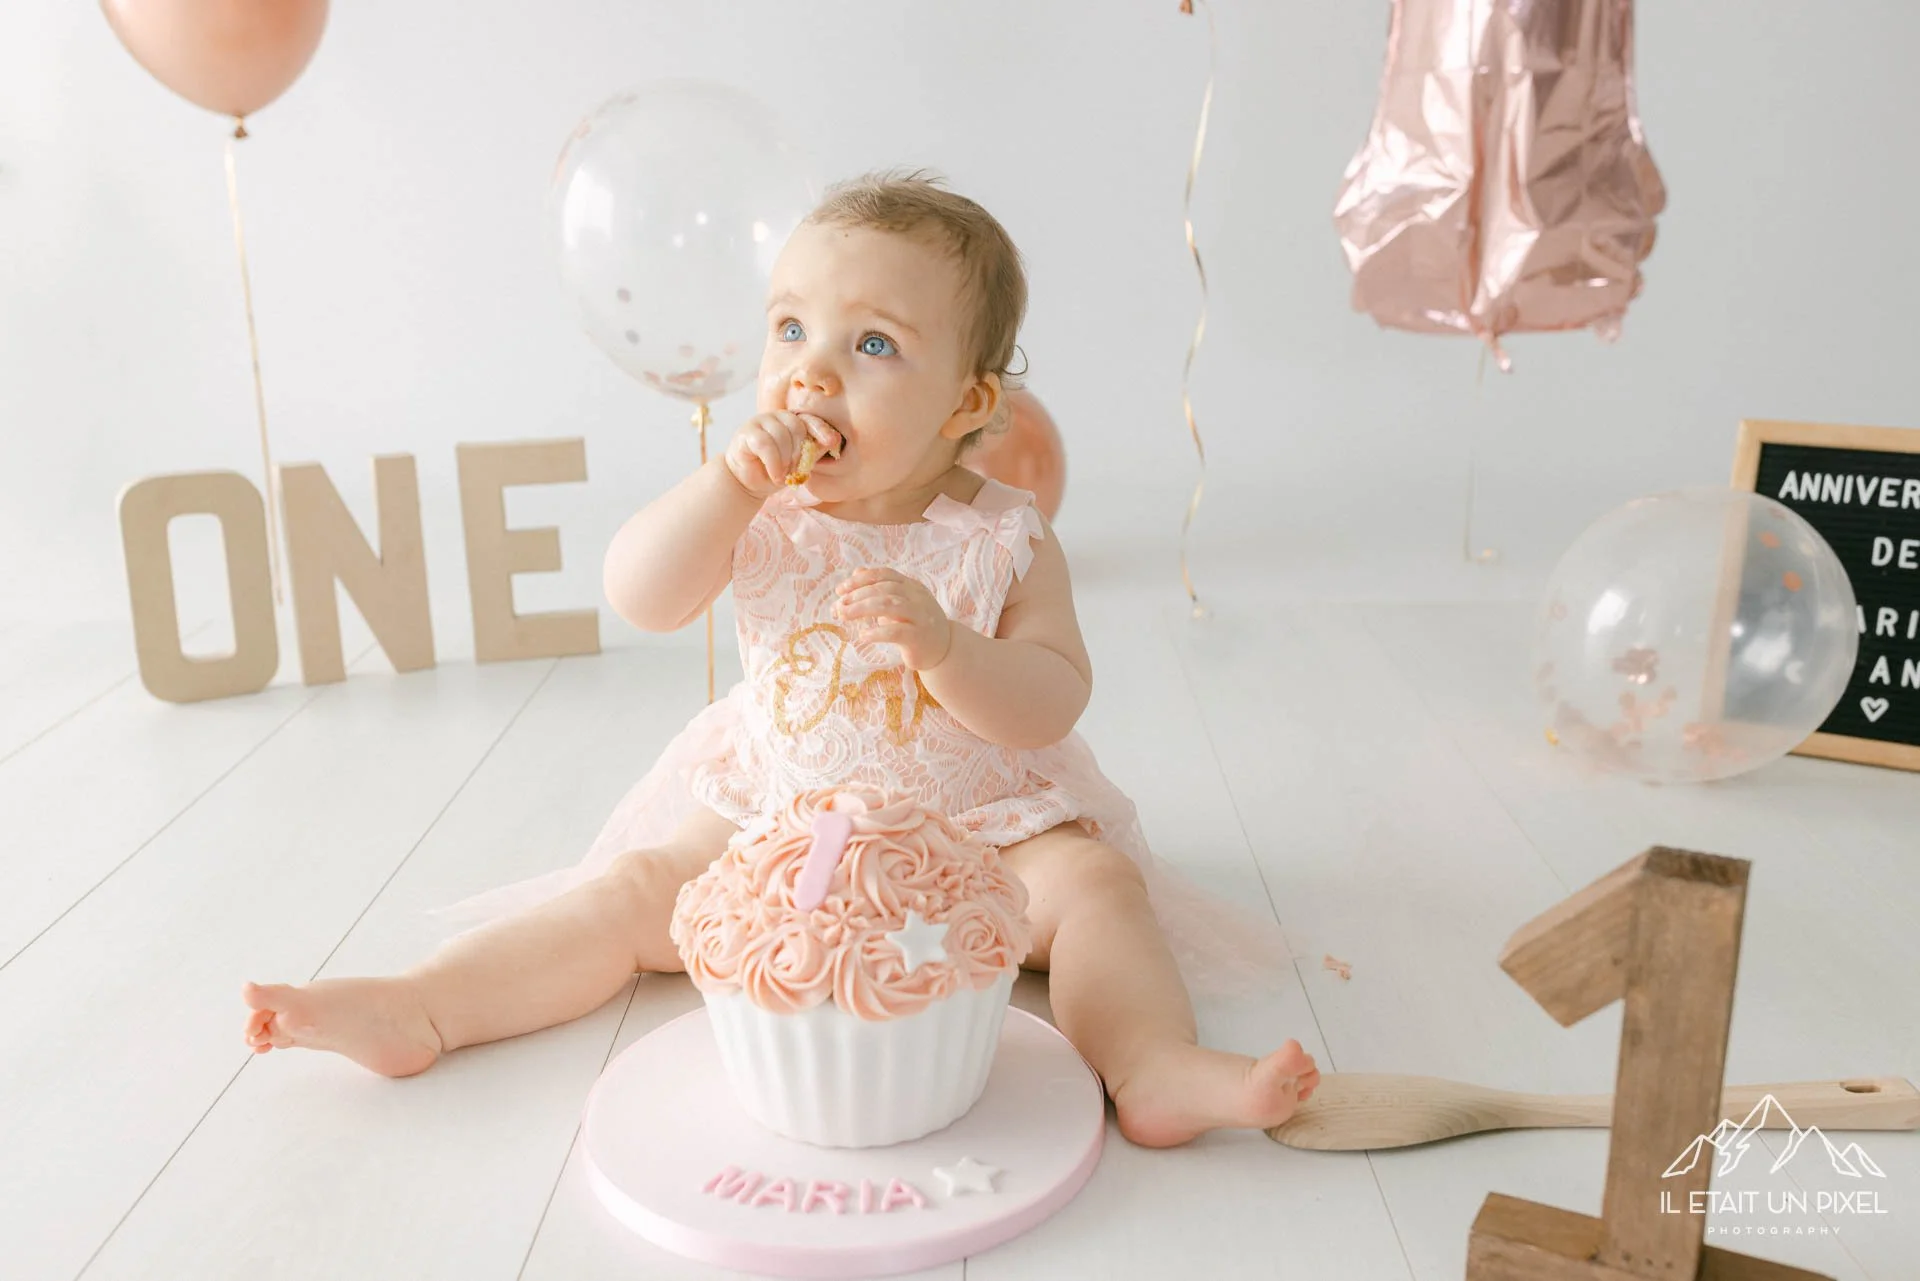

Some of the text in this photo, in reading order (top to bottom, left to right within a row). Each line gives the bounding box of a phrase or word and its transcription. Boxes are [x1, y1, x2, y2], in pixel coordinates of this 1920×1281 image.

[1778, 470, 1920, 509] ANNIVER
[115, 437, 602, 703] ONE
[1871, 536, 1920, 569] DE
[700, 1164, 927, 1214] MARIA
